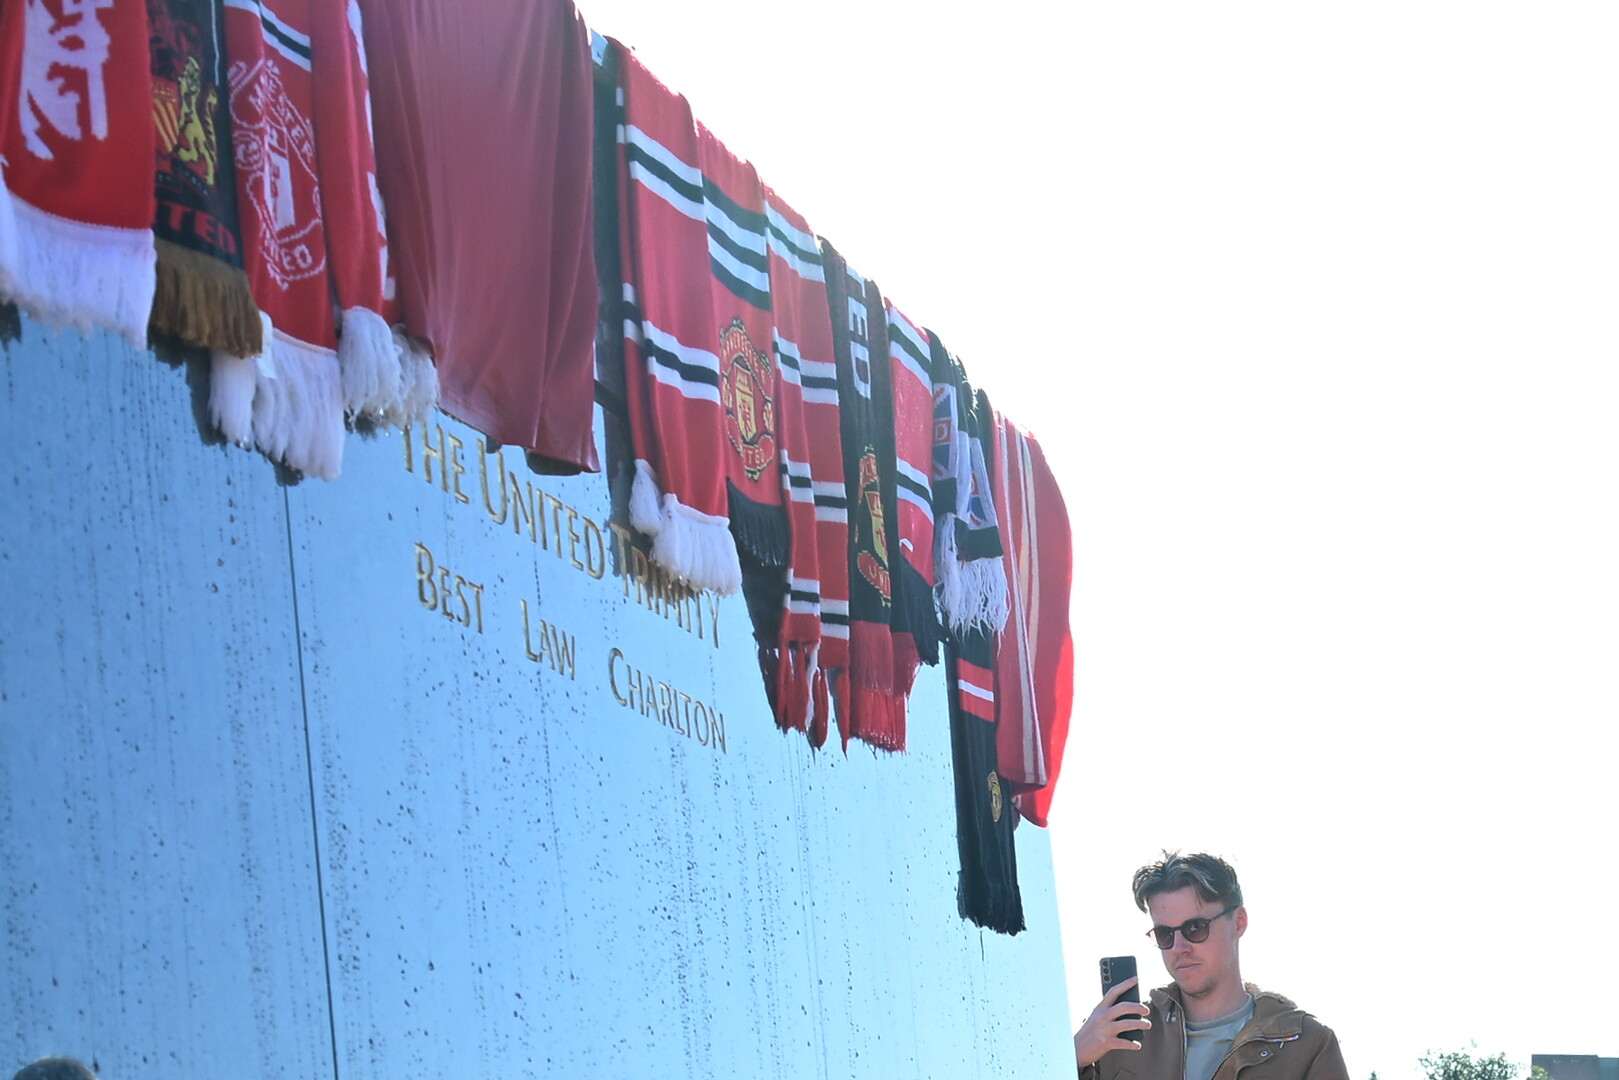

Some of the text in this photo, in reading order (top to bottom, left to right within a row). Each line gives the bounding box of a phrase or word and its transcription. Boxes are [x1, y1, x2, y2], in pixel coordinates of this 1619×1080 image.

[477, 437, 606, 580] UNITED
[413, 542, 727, 755] BEST LAW CHARLTON
